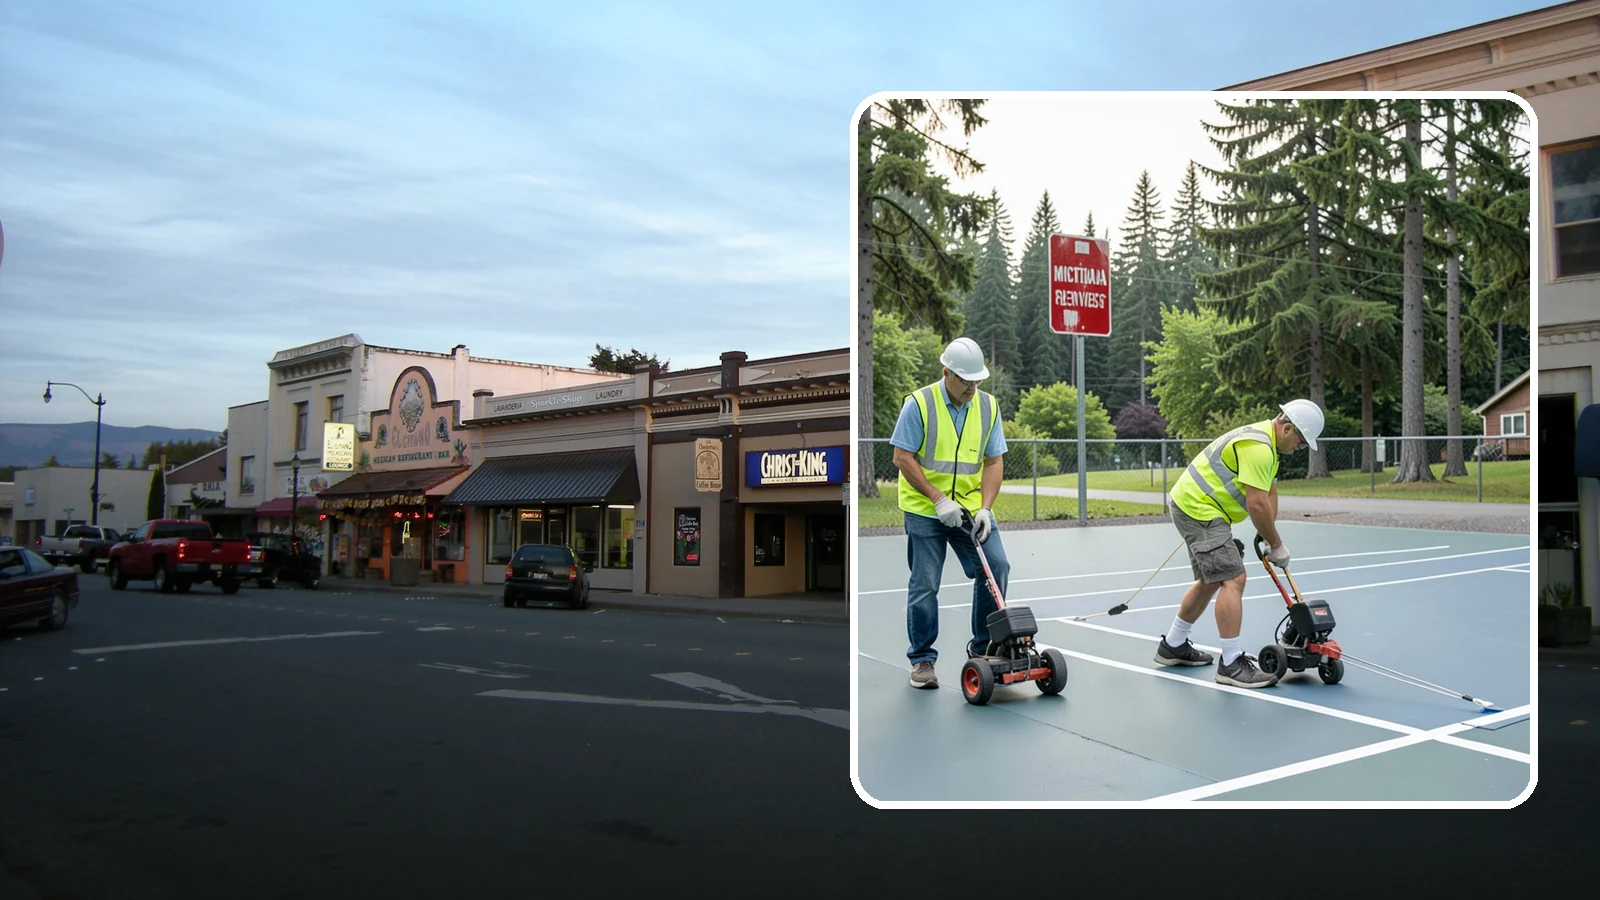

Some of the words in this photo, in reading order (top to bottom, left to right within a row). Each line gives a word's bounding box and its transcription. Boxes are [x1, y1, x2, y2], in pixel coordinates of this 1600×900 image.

[531, 396, 561, 409] Sparkle
[562, 394, 582, 405] Shop
[595, 389, 623, 400] LAUNDRY
[493, 402, 522, 413] LAVANDERIA
[373, 455, 396, 464] MEXICAN
[397, 451, 434, 463] RESTAURANT
[438, 450, 450, 459] BAR
[761, 452, 797, 478] CHRIST
[799, 450, 827, 476] KING
